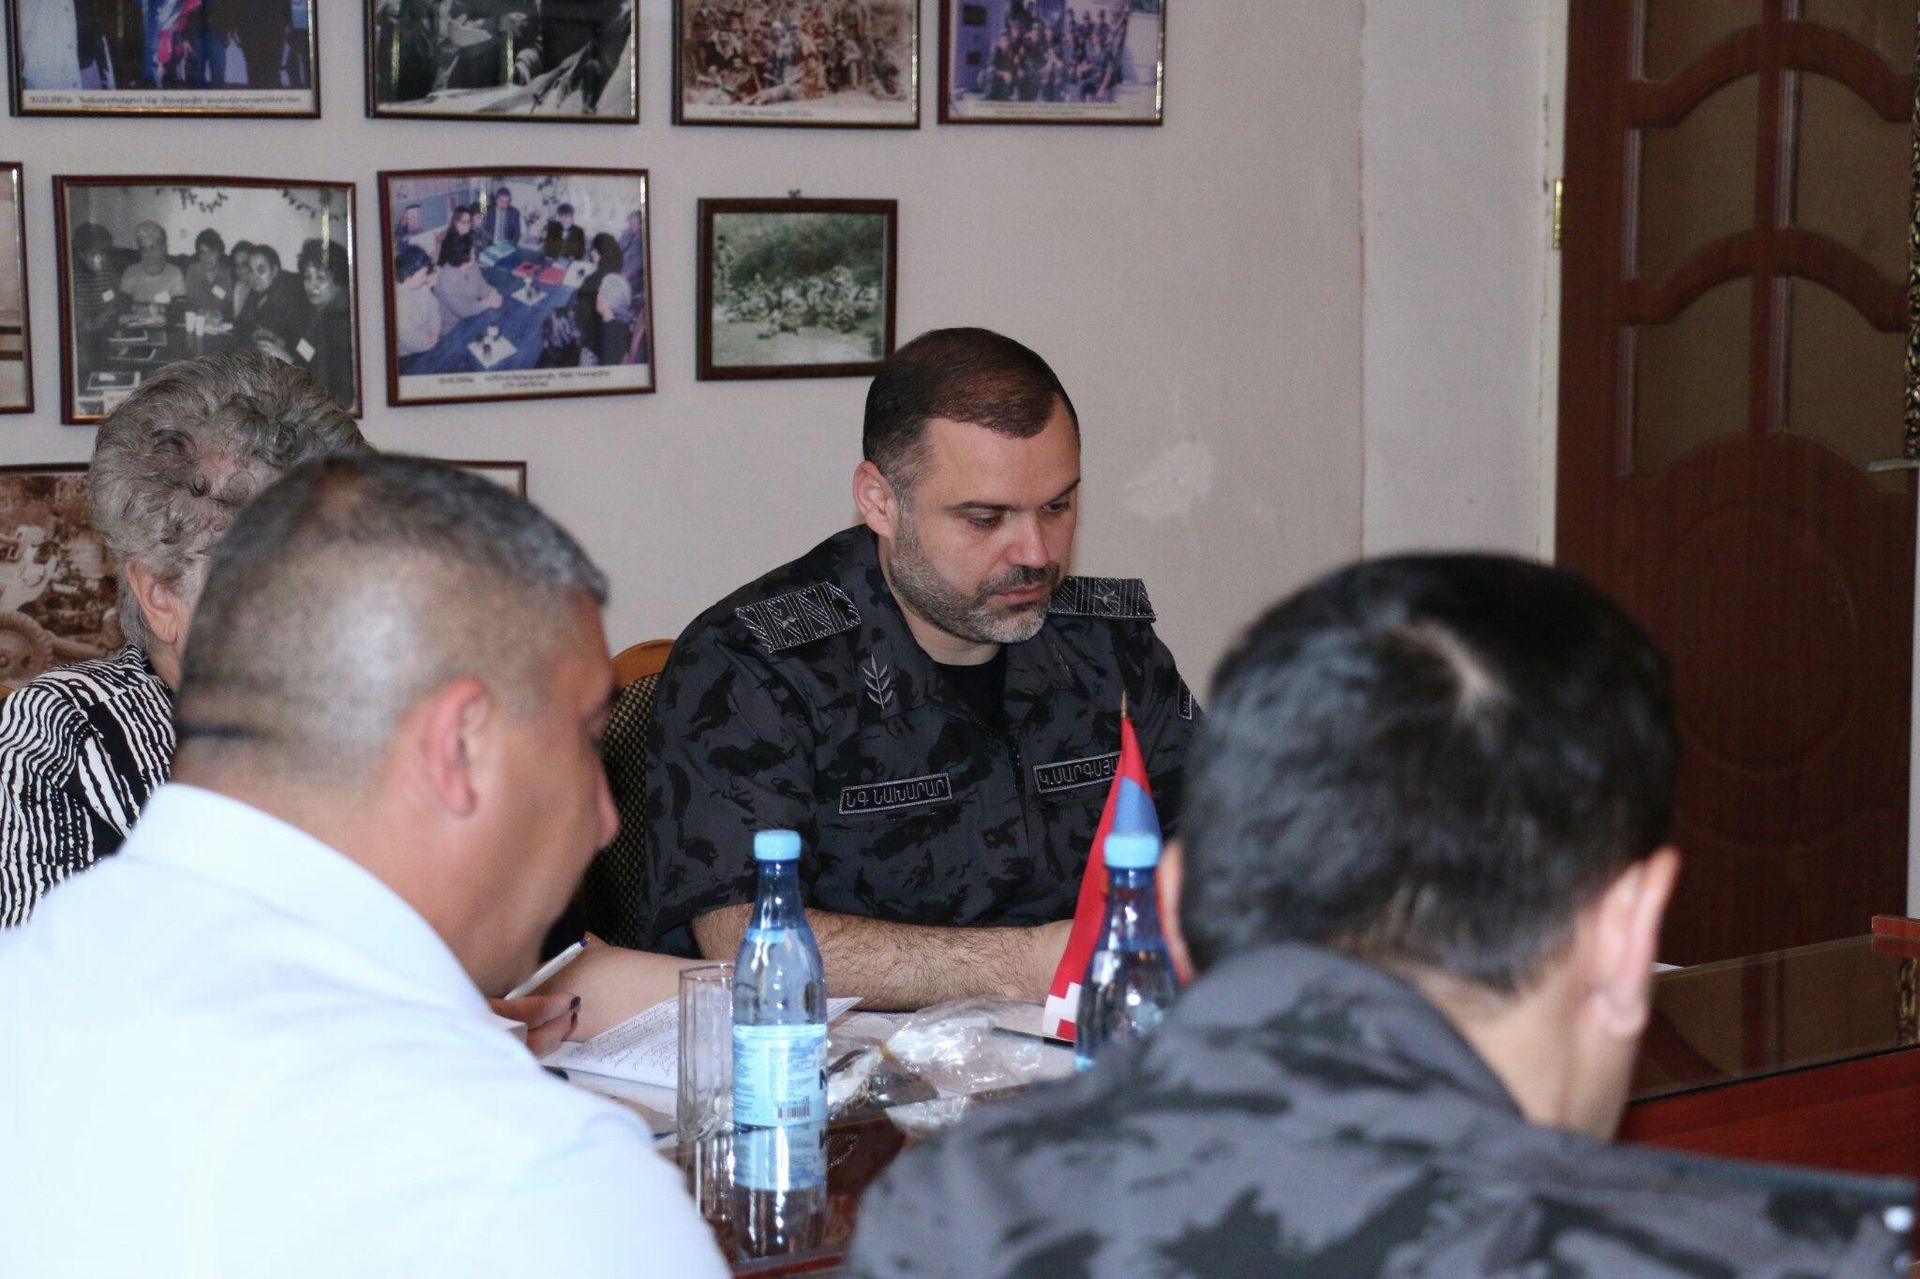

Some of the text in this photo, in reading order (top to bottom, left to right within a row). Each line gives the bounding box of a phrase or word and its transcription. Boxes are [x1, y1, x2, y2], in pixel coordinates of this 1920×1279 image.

[1038, 758, 1119, 786] Կ.ՍԱՐԳՍՅԱ
[846, 779, 945, 808] ՆԳ ՆԱԽԱՐԱՐ
